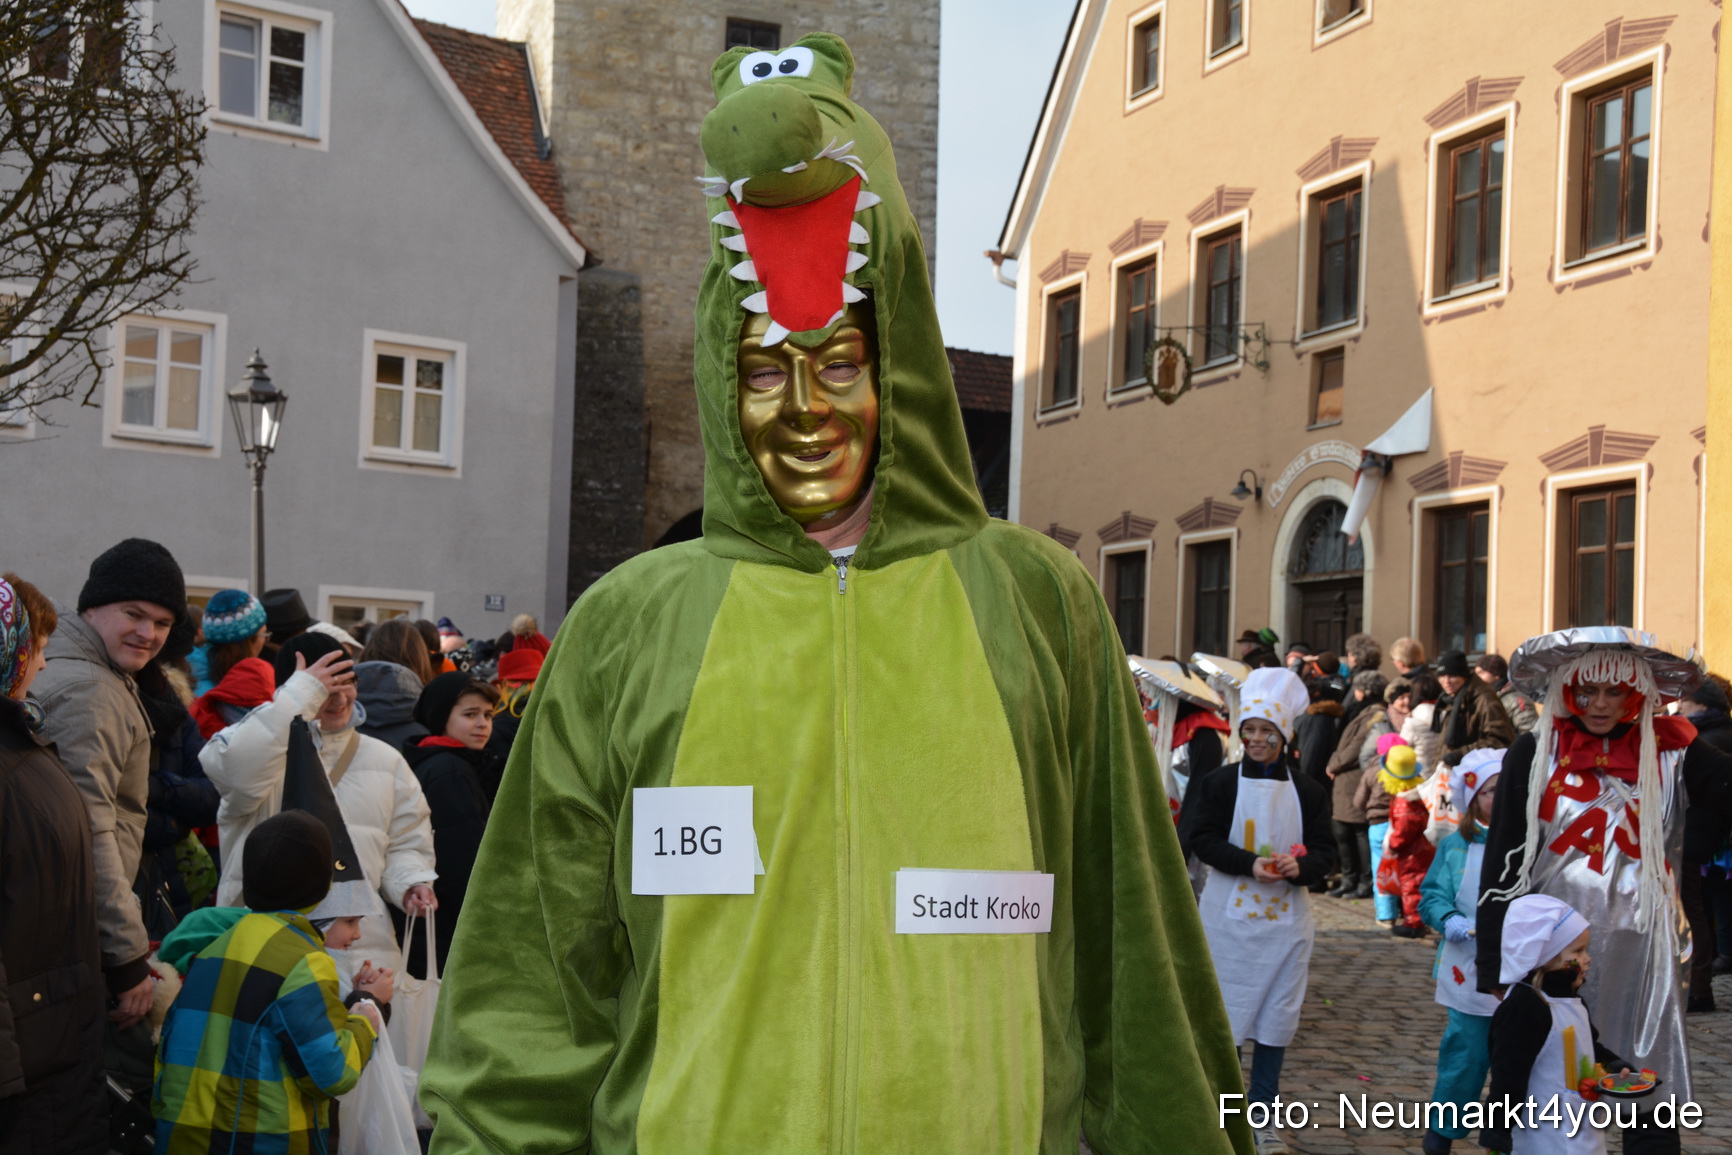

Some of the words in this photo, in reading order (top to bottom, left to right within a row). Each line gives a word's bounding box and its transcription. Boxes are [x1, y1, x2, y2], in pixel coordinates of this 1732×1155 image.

[653, 825, 723, 856] 1.BG
[912, 894, 979, 920] Stadt
[986, 895, 1042, 920] Kroko
